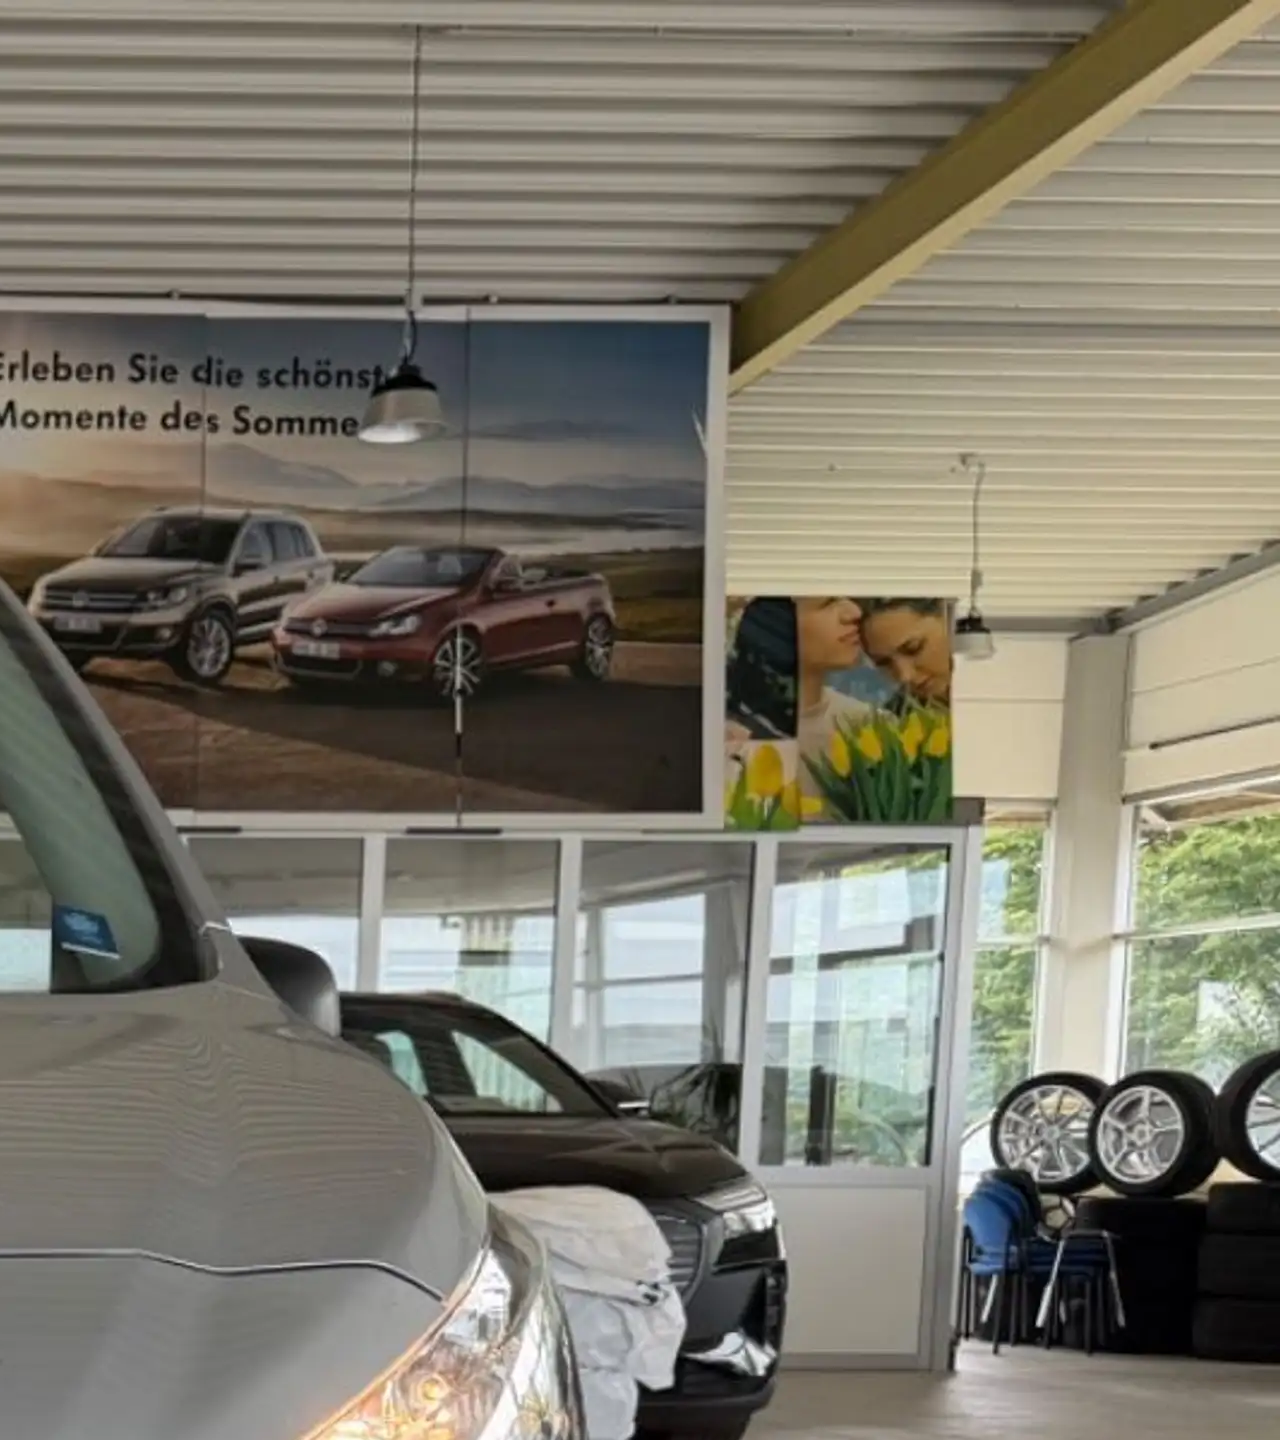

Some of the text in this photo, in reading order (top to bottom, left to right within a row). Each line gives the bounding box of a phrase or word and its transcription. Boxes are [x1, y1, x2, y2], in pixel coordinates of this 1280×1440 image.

[128, 353, 179, 384] Sie
[190, 355, 244, 388] die
[160, 402, 220, 435] des
[232, 405, 359, 437] Somme
